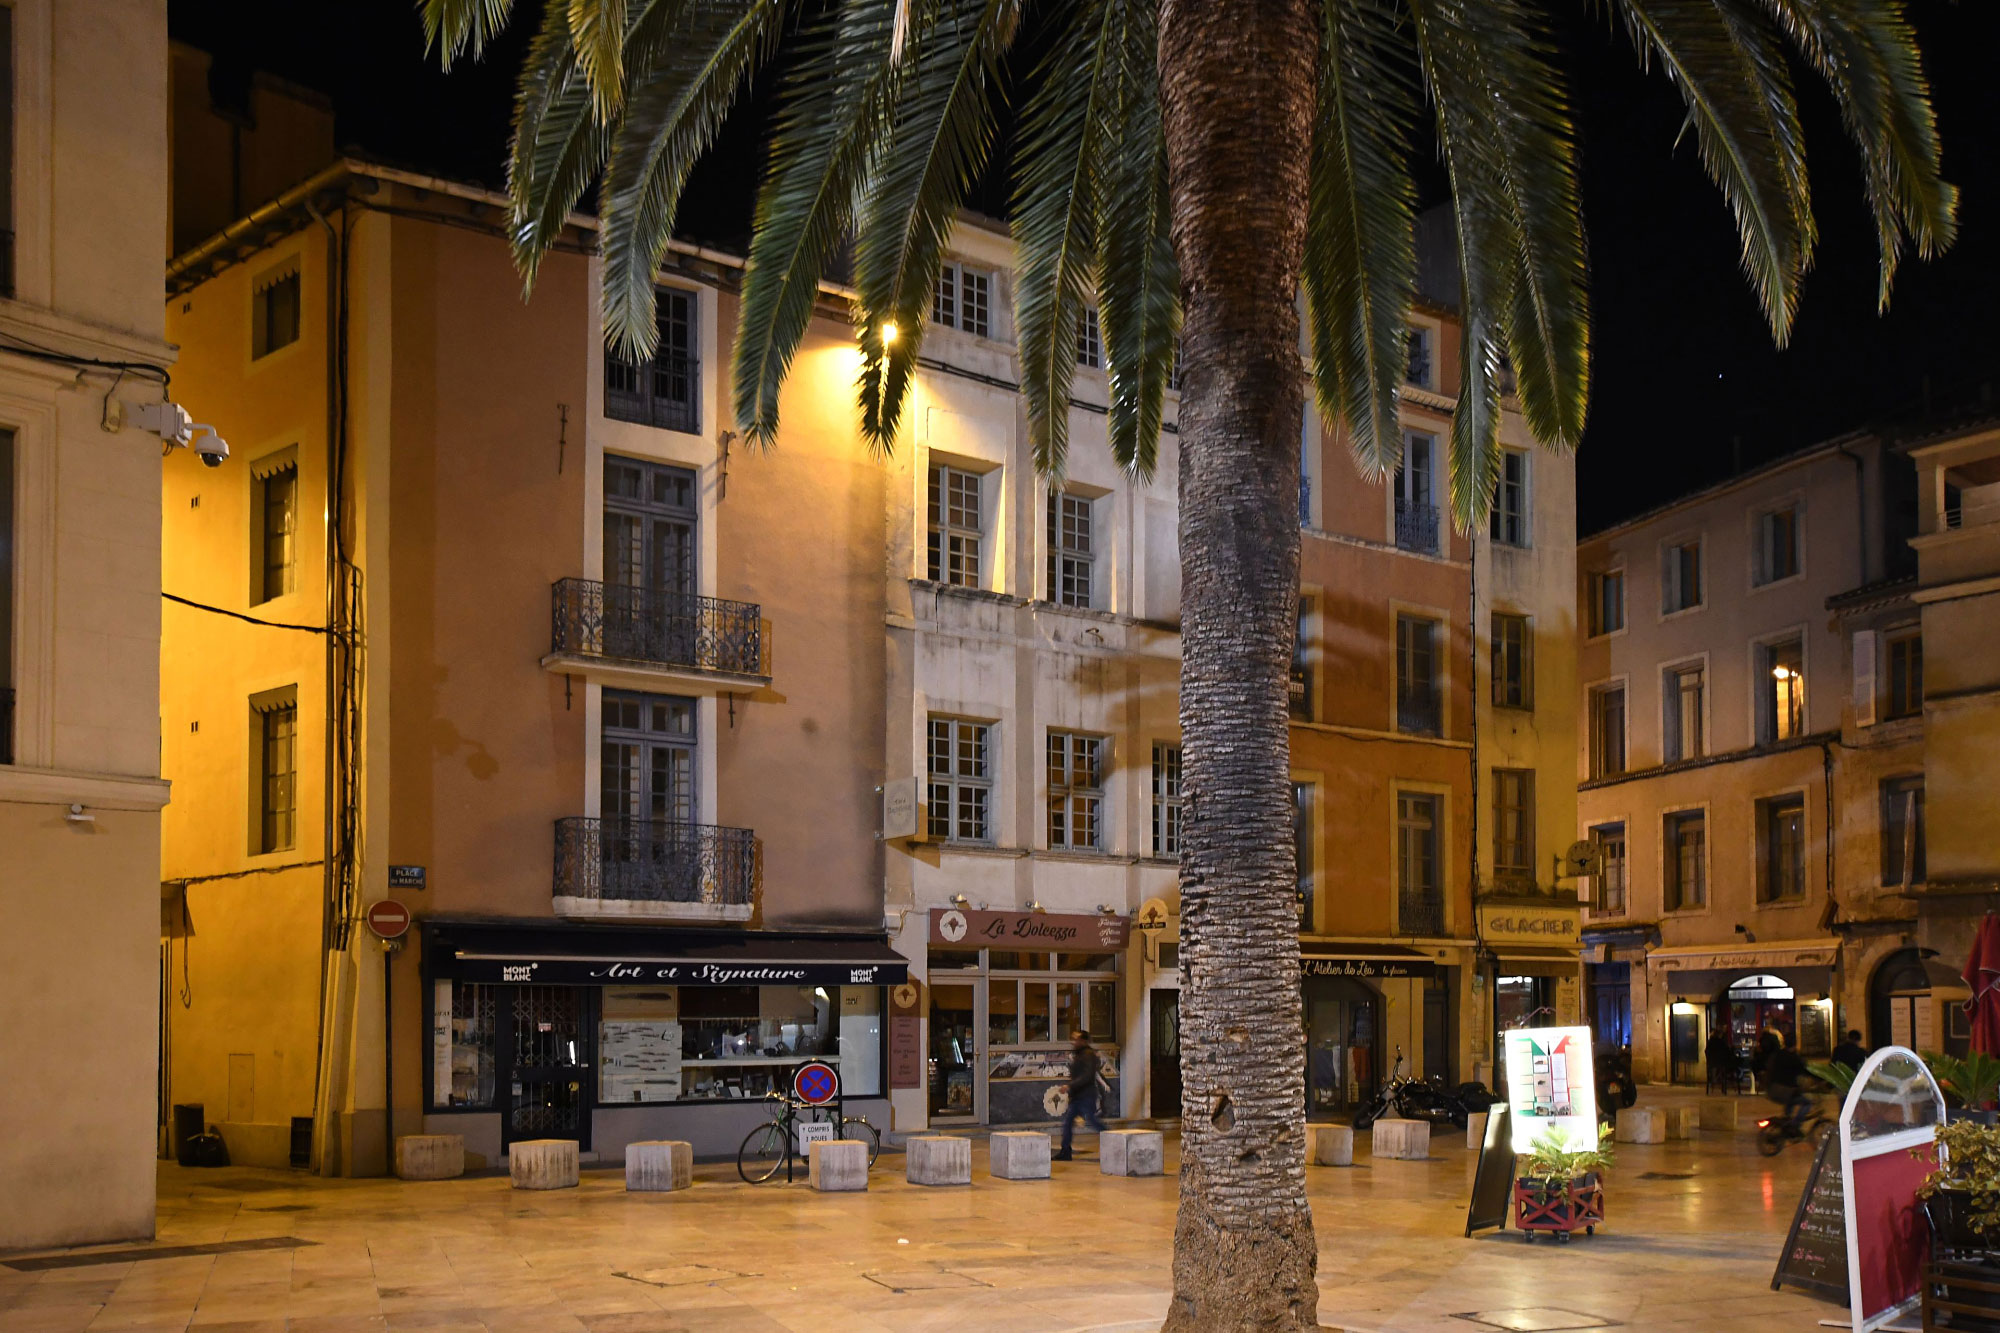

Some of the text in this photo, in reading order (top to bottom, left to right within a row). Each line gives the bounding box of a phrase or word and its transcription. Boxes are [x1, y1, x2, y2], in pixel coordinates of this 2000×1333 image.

[395, 869, 418, 877] PLACE
[980, 917, 1077, 942] La Dolcezza
[1490, 916, 1575, 934] GLACIER
[503, 966, 531, 974] MONT
[590, 962, 807, 983] Art et Signature
[1301, 960, 1375, 977] L'Atelier de Léa
